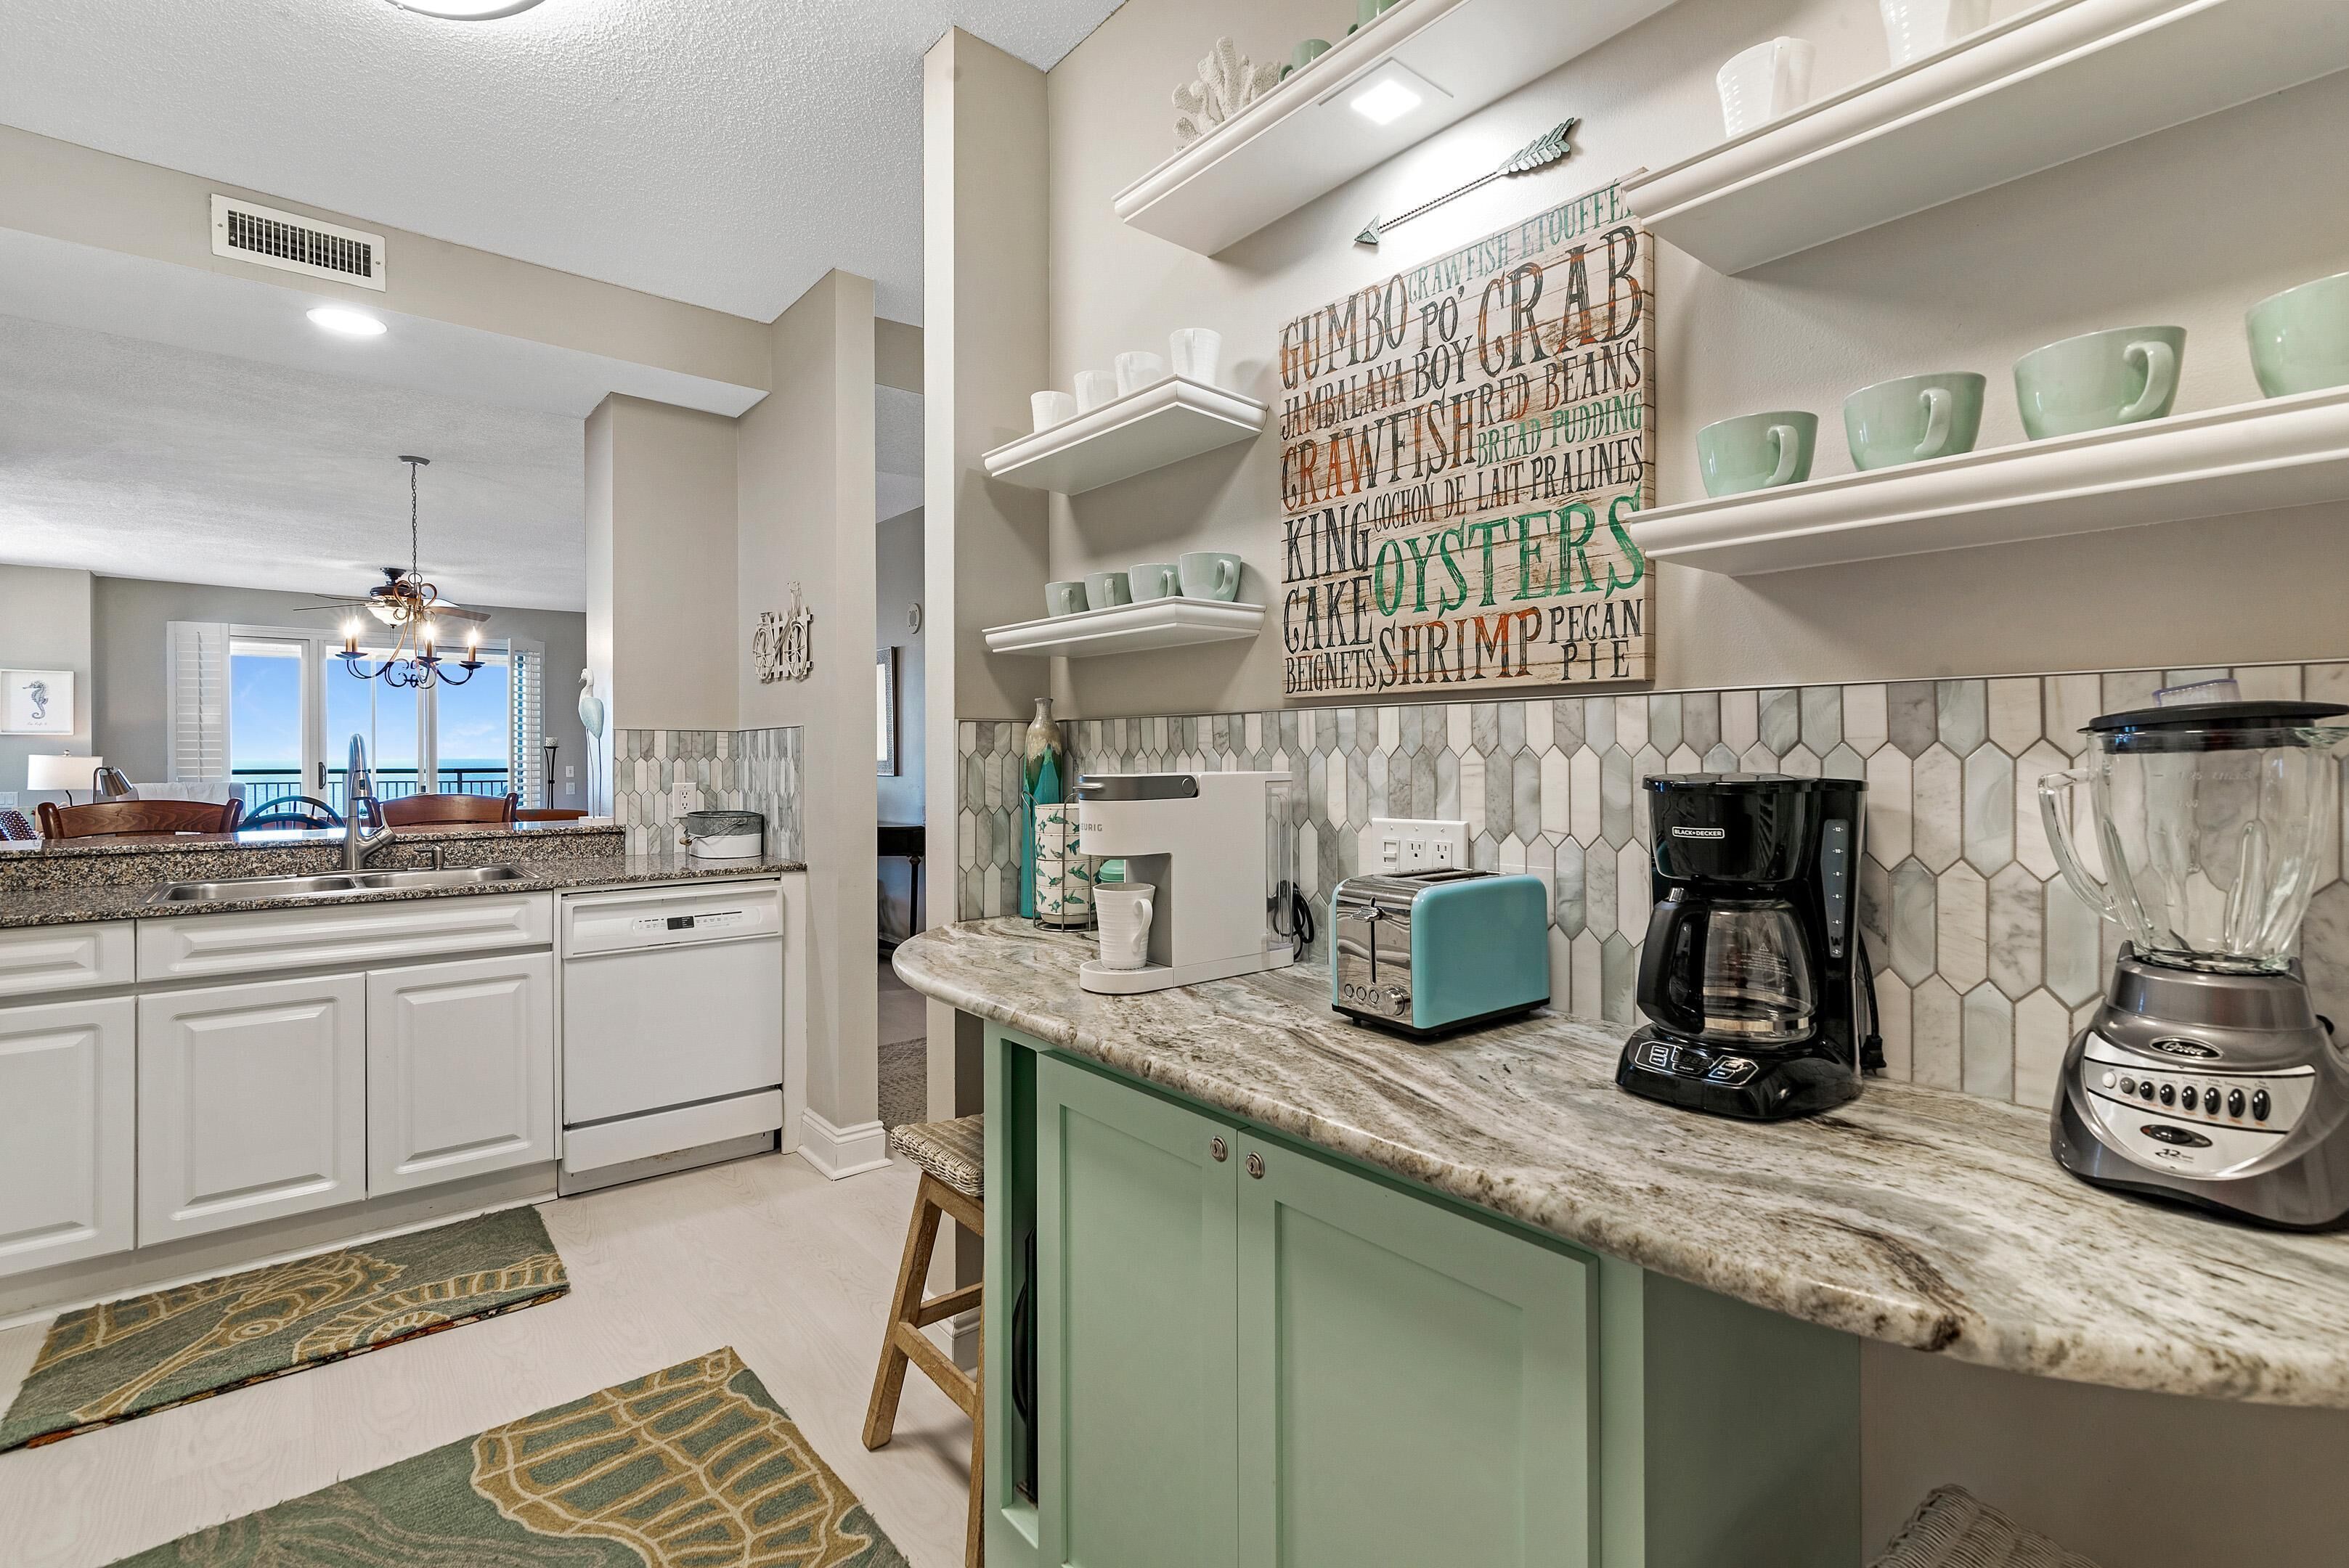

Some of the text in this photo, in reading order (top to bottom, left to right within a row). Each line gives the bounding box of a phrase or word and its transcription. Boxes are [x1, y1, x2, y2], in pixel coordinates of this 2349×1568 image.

[1408, 178, 1634, 304] CRAWFISH ETOUFFÉ
[1282, 273, 1407, 390] GUMBO
[1419, 285, 1465, 352] PO'
[1478, 226, 1642, 378] CRAB
[1280, 358, 1406, 441] JAMBALAYA
[1412, 334, 1473, 400] BOY
[1477, 331, 1641, 429] RED BEANS
[1282, 388, 1477, 512] CRAWFISH
[1475, 389, 1642, 470] BREAD PUDDING
[1530, 429, 1644, 502] PRALINES
[1373, 460, 1525, 533] COCHON DE LAIT
[1283, 502, 1372, 584] KING
[1374, 482, 1645, 620] OYSTERS
[1283, 574, 1373, 655] CAKE
[1377, 605, 1542, 693] SHRIMP
[1547, 598, 1644, 645] PECAN
[1285, 643, 1377, 694] BEIGNETS
[1560, 639, 1629, 681] PIE
